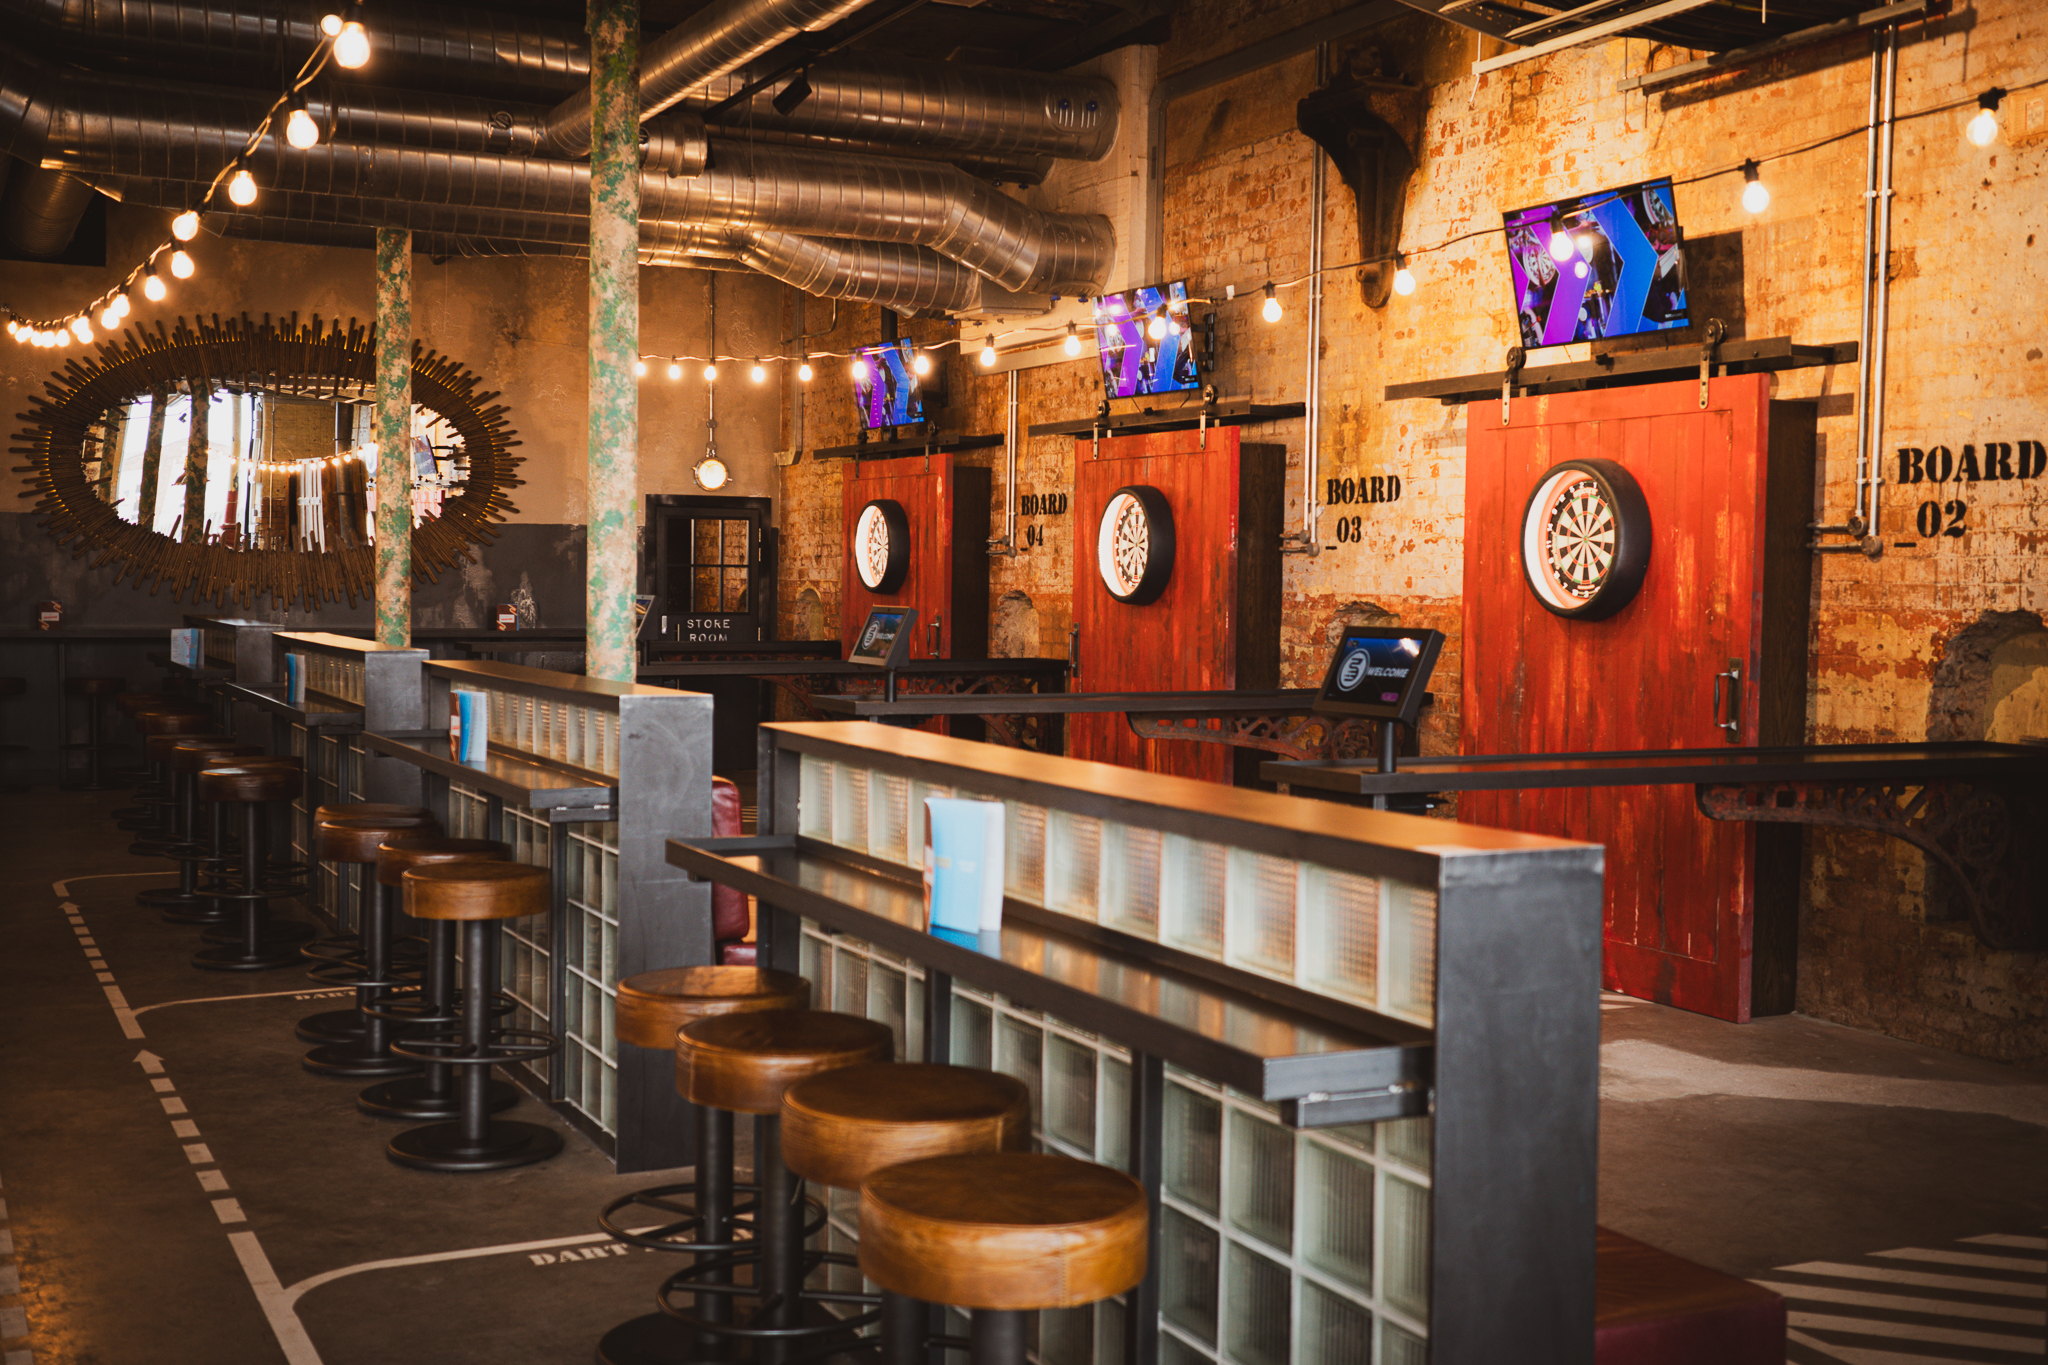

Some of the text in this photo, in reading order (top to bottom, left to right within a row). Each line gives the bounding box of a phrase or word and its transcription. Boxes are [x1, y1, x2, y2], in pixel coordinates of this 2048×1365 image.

[1897, 440, 2047, 484] BOARD
[1326, 475, 1401, 505] BOARD
[1021, 492, 1068, 516] BOARD
[686, 618, 731, 629] STORE
[689, 633, 728, 641] ROOM
[1366, 666, 1411, 679] WELCOME
[528, 1242, 629, 1266] DART
